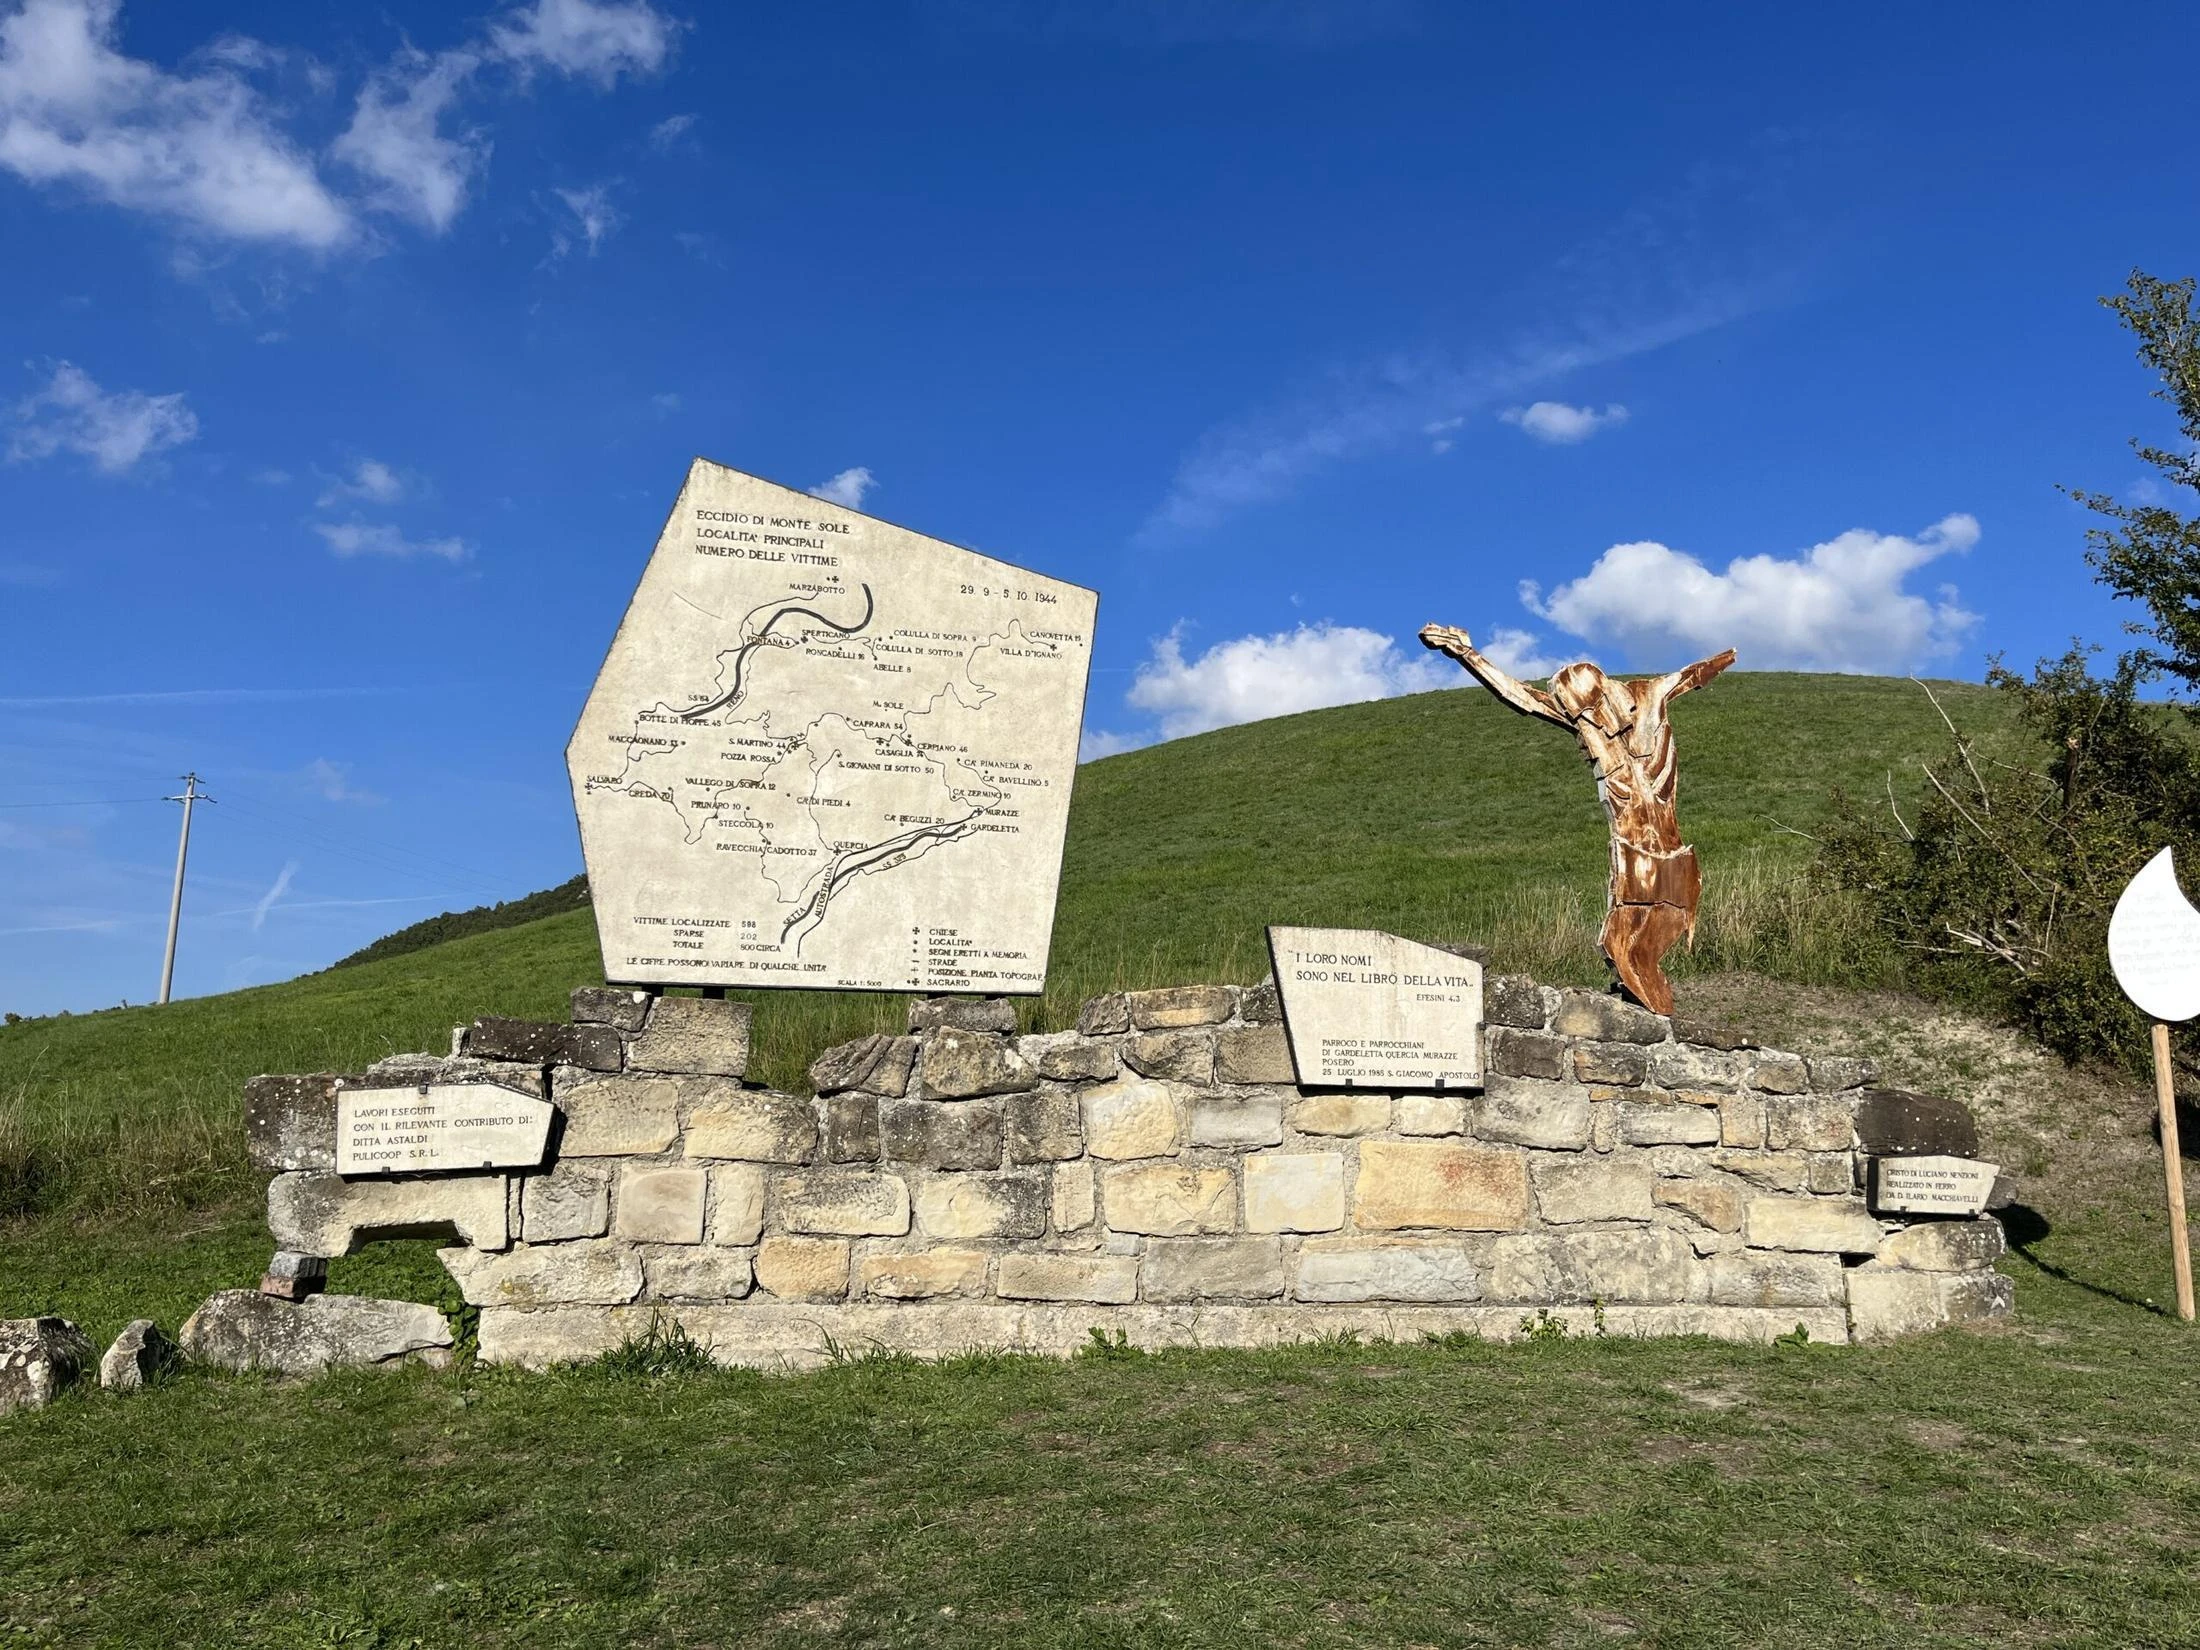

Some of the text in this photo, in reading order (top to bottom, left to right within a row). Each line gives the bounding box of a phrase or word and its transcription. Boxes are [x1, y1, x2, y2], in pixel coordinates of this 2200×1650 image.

[697, 510, 850, 535] ECCIDIO DI MONTE SOLE
[764, 535, 824, 549] PRINCIPALI
[696, 545, 838, 567] NUMERO DELLE VITTIME
[789, 583, 845, 595] MARZABOTTO
[1035, 592, 1057, 604] 1944
[801, 629, 850, 639] SPERTICANO
[894, 629, 930, 639] COLULLA
[943, 633, 967, 641] SOPRA
[1030, 631, 1073, 641] CANOVETTA
[747, 635, 784, 646] FONTANA
[806, 648, 856, 660] RONCADELLI
[875, 643, 912, 654] COLULLA
[915, 647, 924, 655] DI
[928, 649, 953, 657] SOTTO
[1000, 647, 1022, 657] VILLA
[873, 663, 904, 673] ABELLE
[727, 690, 744, 709] RENO
[883, 701, 904, 709] SOLE
[639, 714, 667, 723] BOTTE
[670, 716, 678, 724] DI
[853, 720, 891, 730] CAPRARA
[736, 738, 773, 748] MARTINO
[721, 752, 776, 763] POZZA ROSSA
[875, 748, 914, 758] CASAGLIA
[846, 762, 881, 771] GIOVANNI
[895, 765, 921, 773] SOTTO
[587, 775, 622, 785] SALVARO
[685, 777, 723, 787] VALLEGO
[628, 790, 658, 799] CREDA
[985, 808, 1020, 817] MURAZZE
[718, 819, 763, 829] STECCOLA
[970, 823, 1020, 833] GARDELETTA
[716, 843, 763, 853] RAVECCHIA
[767, 846, 806, 856] CADOTTO
[833, 841, 869, 850] QUERCIA
[815, 866, 833, 918] AUTOSTRADA
[633, 916, 668, 925] VITTIME
[671, 918, 731, 928] LOCALIZZATE
[783, 907, 806, 926] SETTA
[674, 929, 757, 940] SPARSE 202
[929, 928, 958, 937] CHIESE
[673, 941, 704, 949] TOTALE
[756, 944, 781, 953] CIRCA
[928, 948, 952, 956] SEGNI
[953, 949, 982, 957] ERETTI
[626, 957, 638, 965] LE
[640, 958, 665, 966] CIFRE
[749, 961, 759, 969] DI
[761, 962, 799, 971] QUALCHE
[928, 958, 958, 967] STRADE
[1306, 953, 1337, 965] LORO
[1341, 954, 1371, 966] NOMI
[928, 968, 967, 977] POSIZIONE
[971, 970, 998, 979] PIANTA
[1296, 971, 1328, 982] SONO
[1333, 972, 1356, 983] NEL
[1361, 973, 1398, 985] LIBRO
[1404, 976, 1441, 987] DELLA
[927, 978, 970, 987] SACRARIO
[1416, 993, 1445, 1002] EFESINI
[1322, 1039, 1358, 1048] PARROCO
[1369, 1040, 1425, 1049] PARROCCHIANI
[1322, 1049, 1458, 1061] DI GARDELETTA QUERCIA MURAZZE
[1322, 1059, 1354, 1067] POSERO
[1322, 1068, 1332, 1076] 25
[1338, 1069, 1366, 1077] LUGLIO
[1396, 1070, 1434, 1079] GIACOMO
[1438, 1071, 1480, 1080] APOSTOLO
[354, 1106, 435, 1118] LAVORI ESEGUITI
[353, 1122, 375, 1132] CON
[381, 1122, 391, 1131] IL
[395, 1120, 448, 1130] RILEVANTE
[454, 1116, 514, 1128] CONTRIBUTO
[353, 1135, 428, 1146] DITTA ASTALDI
[353, 1150, 402, 1161] PULICOOP
[1887, 1169, 1909, 1177] CRISTO
[1919, 1170, 1948, 1178] LUCIANO
[1950, 1171, 1979, 1179] NENZIONI
[1886, 1181, 1924, 1189] REALIZZATO
[1932, 1194, 1979, 1203] MACCHIAVELLI
